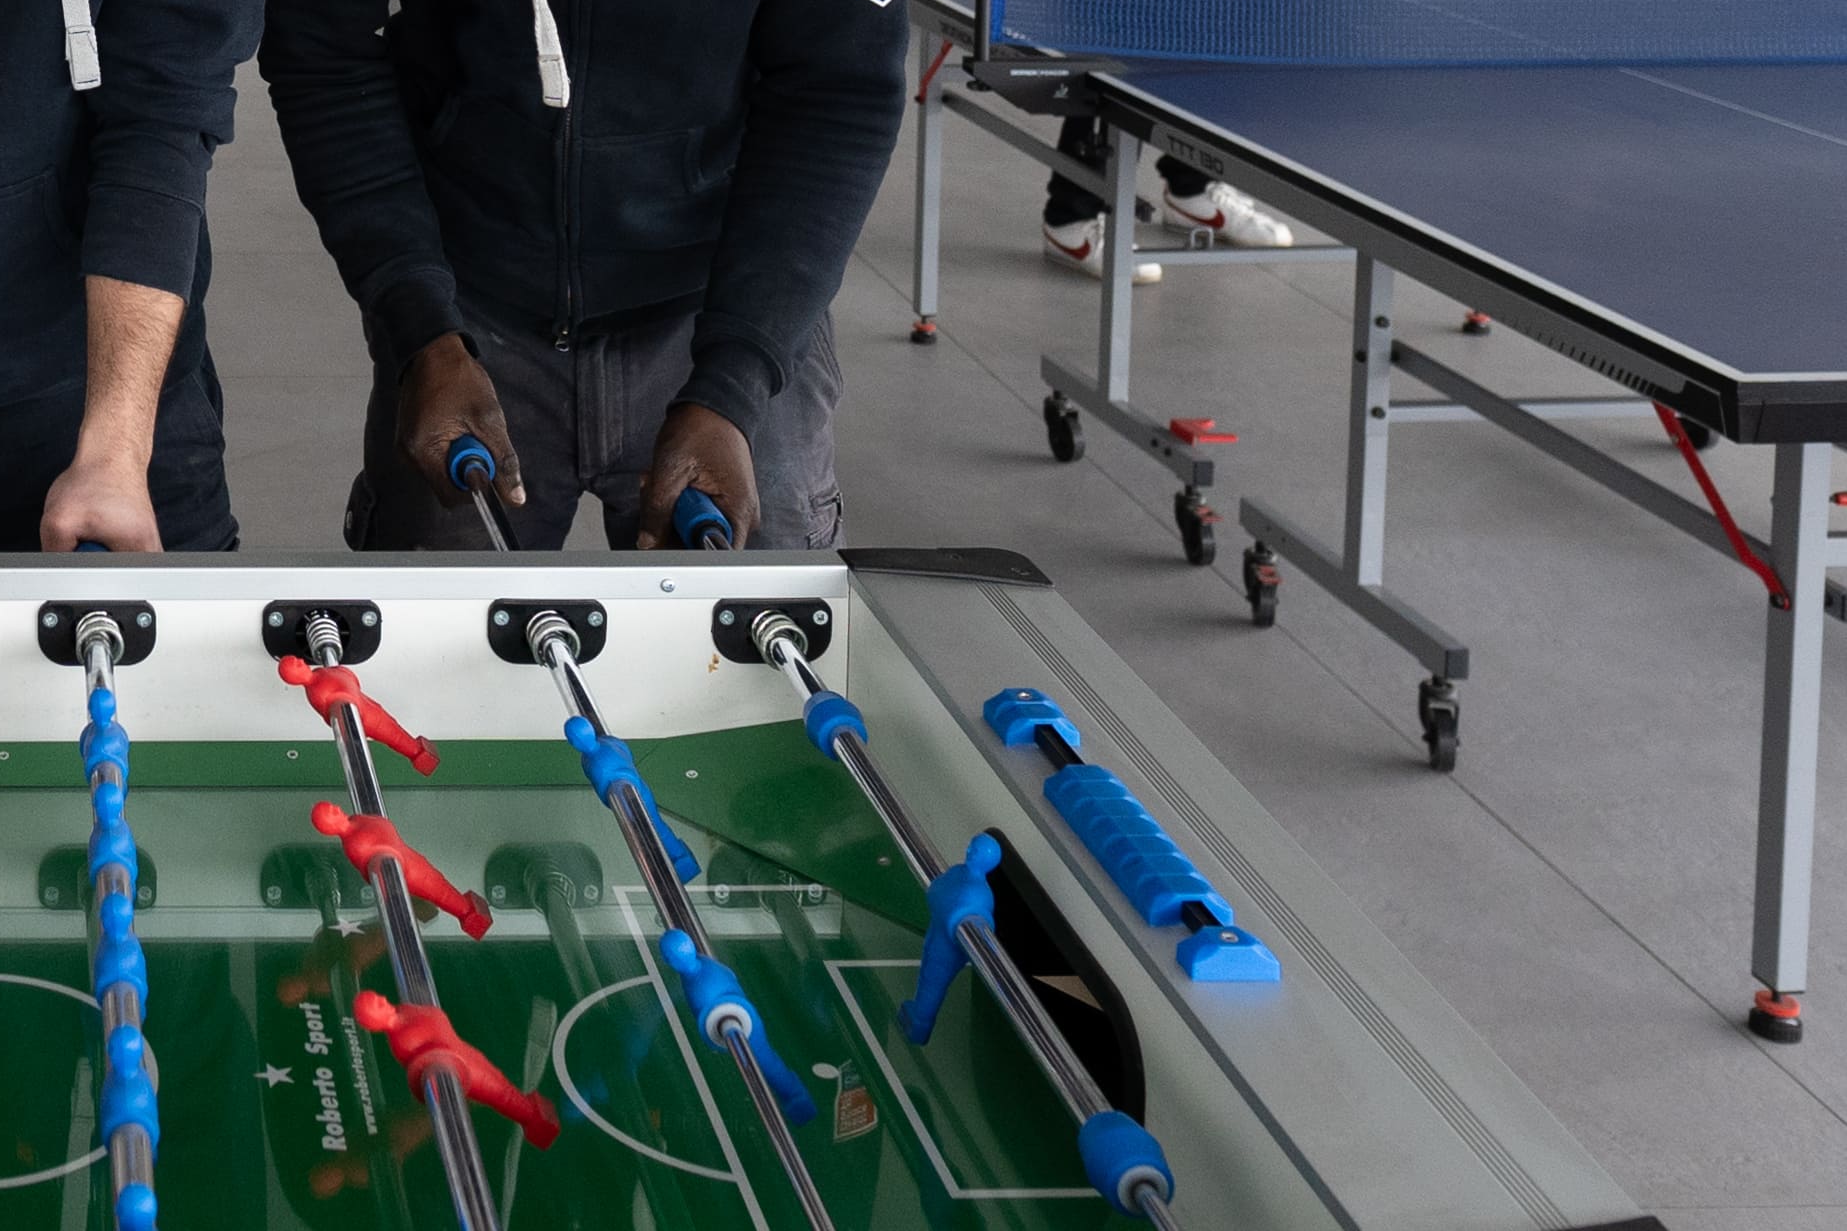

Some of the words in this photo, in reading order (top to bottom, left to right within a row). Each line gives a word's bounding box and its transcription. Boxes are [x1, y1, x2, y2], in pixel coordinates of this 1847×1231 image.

[299, 1002, 333, 1056] Sport
[312, 1067, 348, 1151] Roberto
[341, 1016, 378, 1135] www.robertosport.it
